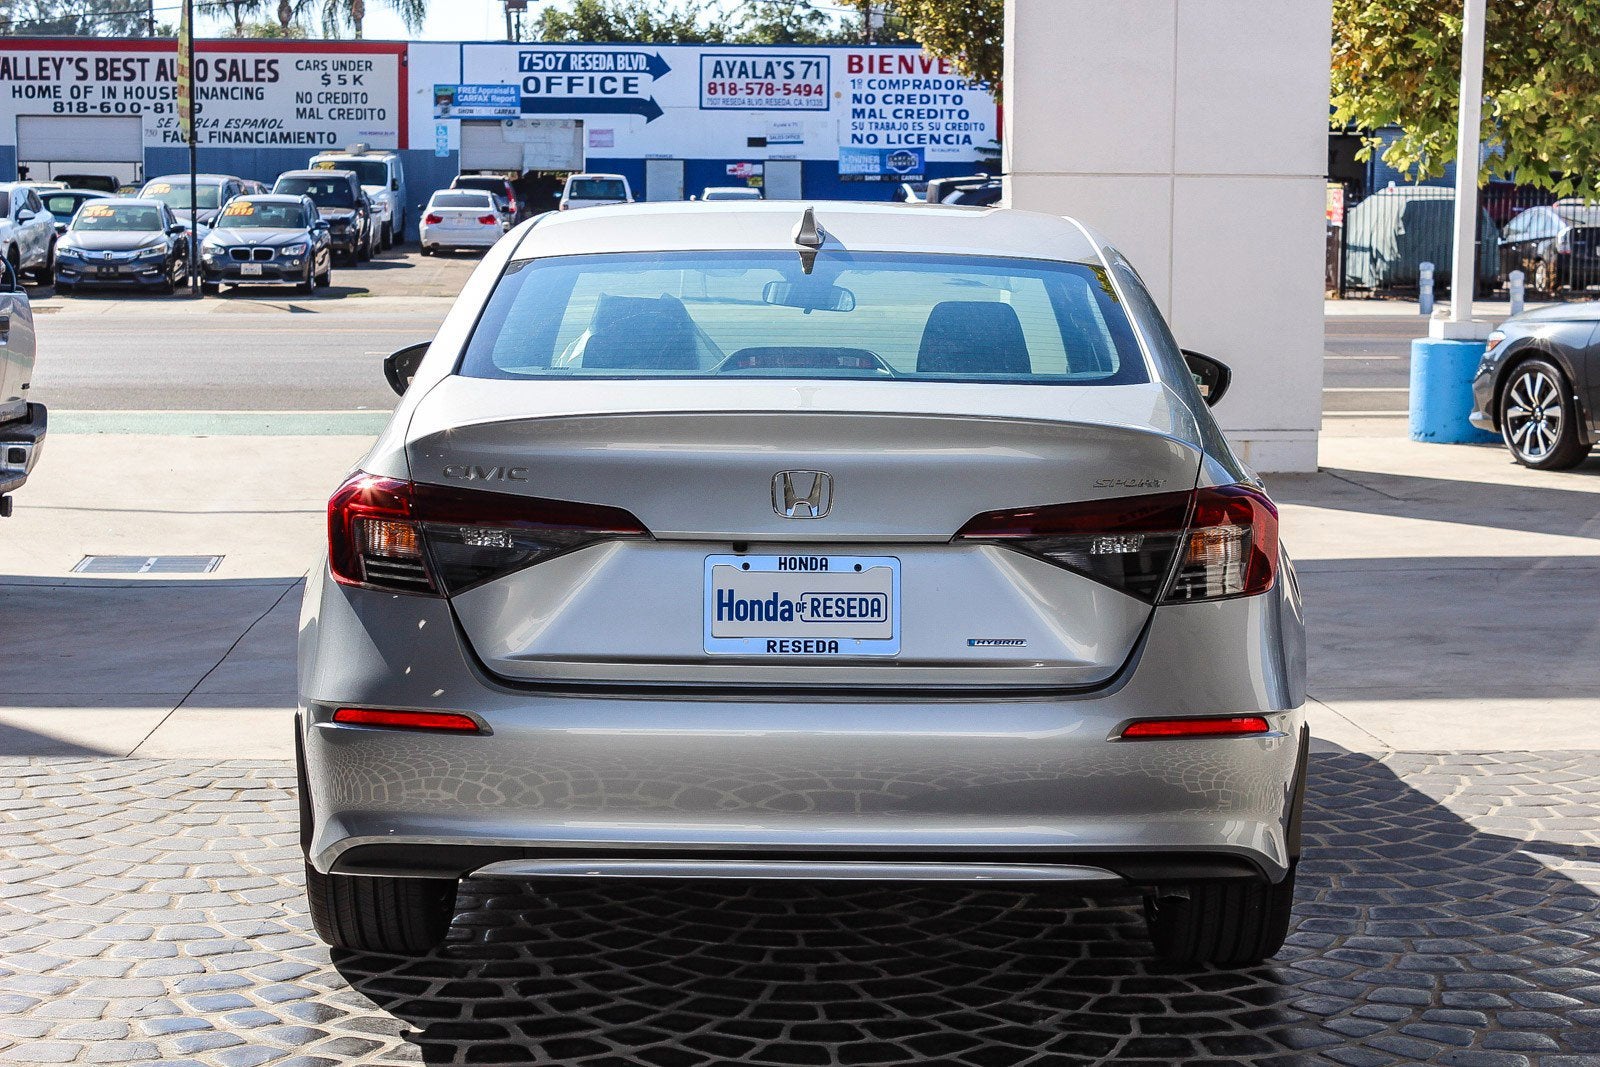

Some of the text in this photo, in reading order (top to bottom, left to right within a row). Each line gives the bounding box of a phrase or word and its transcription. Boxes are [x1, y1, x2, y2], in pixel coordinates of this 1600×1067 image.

[295, 60, 373, 72] CARS UNDER
[521, 53, 650, 71] 7507 RESEDA BLVD.
[0, 57, 279, 83] ALLEY'S BEST AUO SALES
[712, 60, 821, 79] AYALA'S 71
[457, 86, 477, 94] FREE
[522, 76, 639, 94] OFFICE
[707, 82, 824, 96] 818-578-5494
[867, 79, 990, 91] COMPRADORES
[12, 85, 62, 99] HOME
[70, 85, 94, 99] OF
[102, 86, 117, 99] IN
[195, 87, 264, 100] INANCING
[295, 92, 368, 104] NO CREDITO
[852, 93, 964, 105] NO CREDITO
[53, 102, 203, 114] 818-600-819
[296, 108, 386, 121] MAL CREDITO
[852, 108, 970, 120] MAL CREDITO
[157, 118, 284, 129] SE BLA ESPAÑOL
[851, 122, 985, 131] SU TRABAJO ES SU CREDITO
[163, 131, 337, 145] FAL FINANCIAMIENTO
[851, 133, 972, 145] NO LICENCIA
[443, 464, 529, 482] CIVIC
[778, 557, 828, 571] HONDA
[717, 589, 881, 621] Honda OF RESEDA
[766, 640, 839, 653] RESEDA
